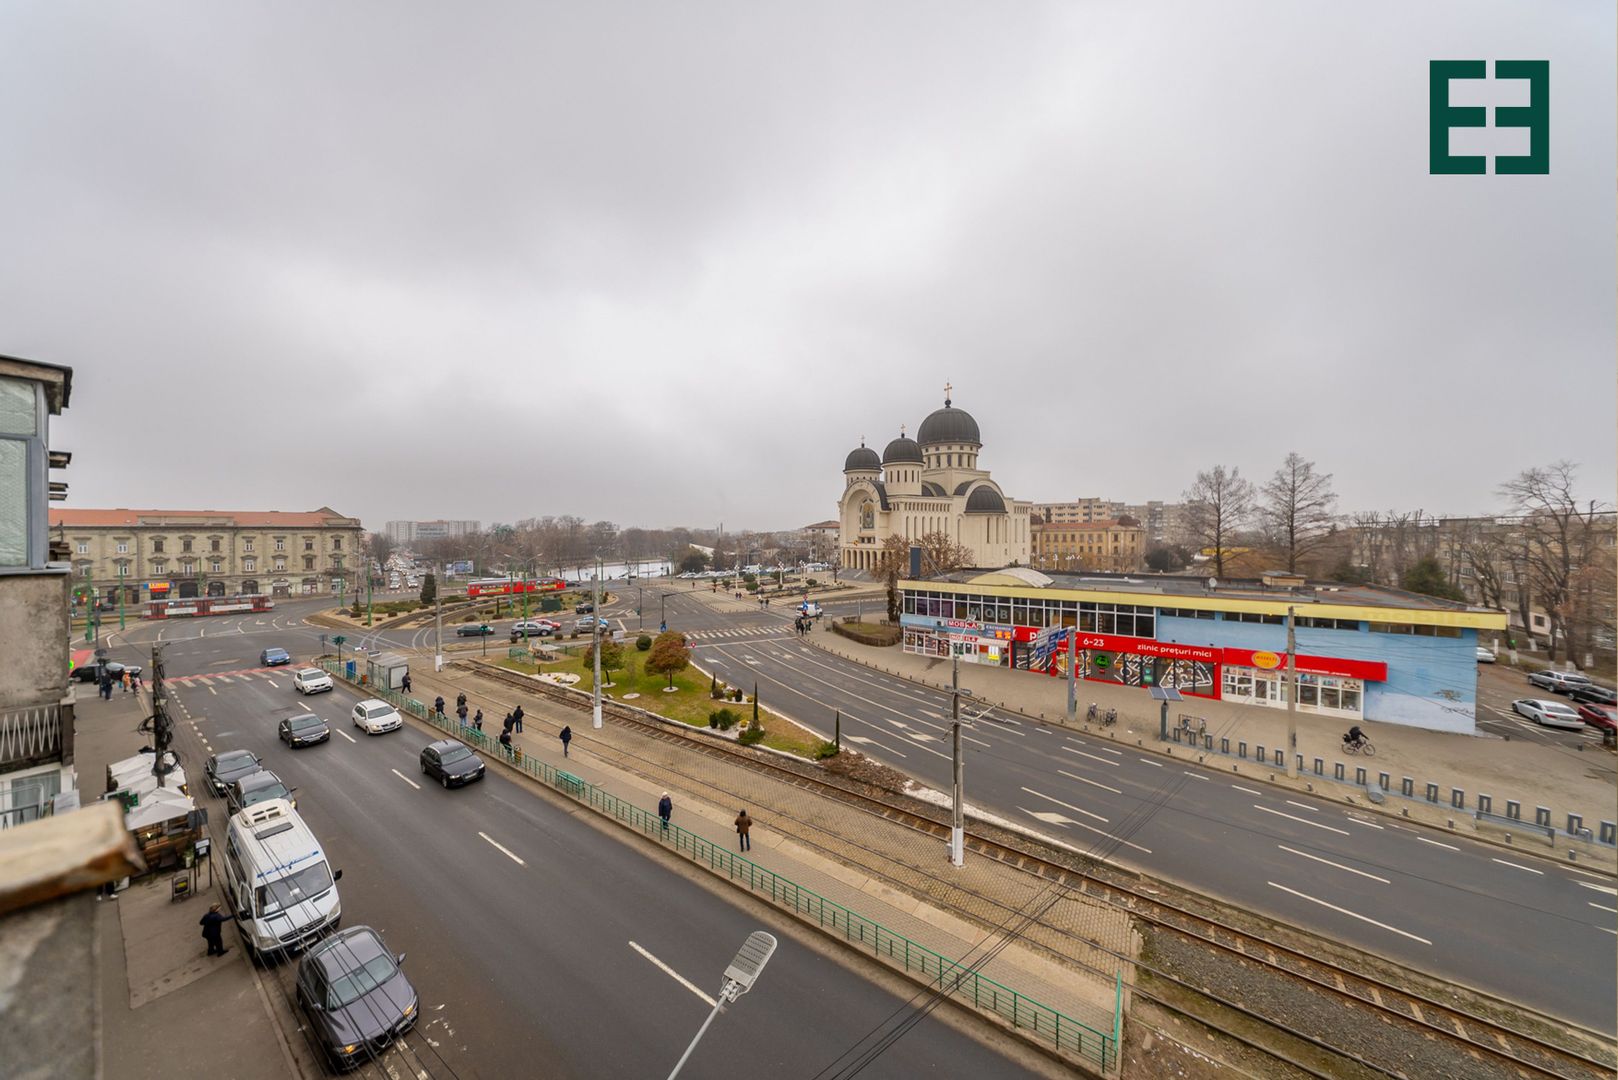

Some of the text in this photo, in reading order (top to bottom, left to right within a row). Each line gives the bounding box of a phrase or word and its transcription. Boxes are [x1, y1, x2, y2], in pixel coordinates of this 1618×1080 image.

[1083, 638, 1105, 647] 6-23
[1137, 644, 1159, 652] zilnic
[1192, 650, 1212, 658] mici
